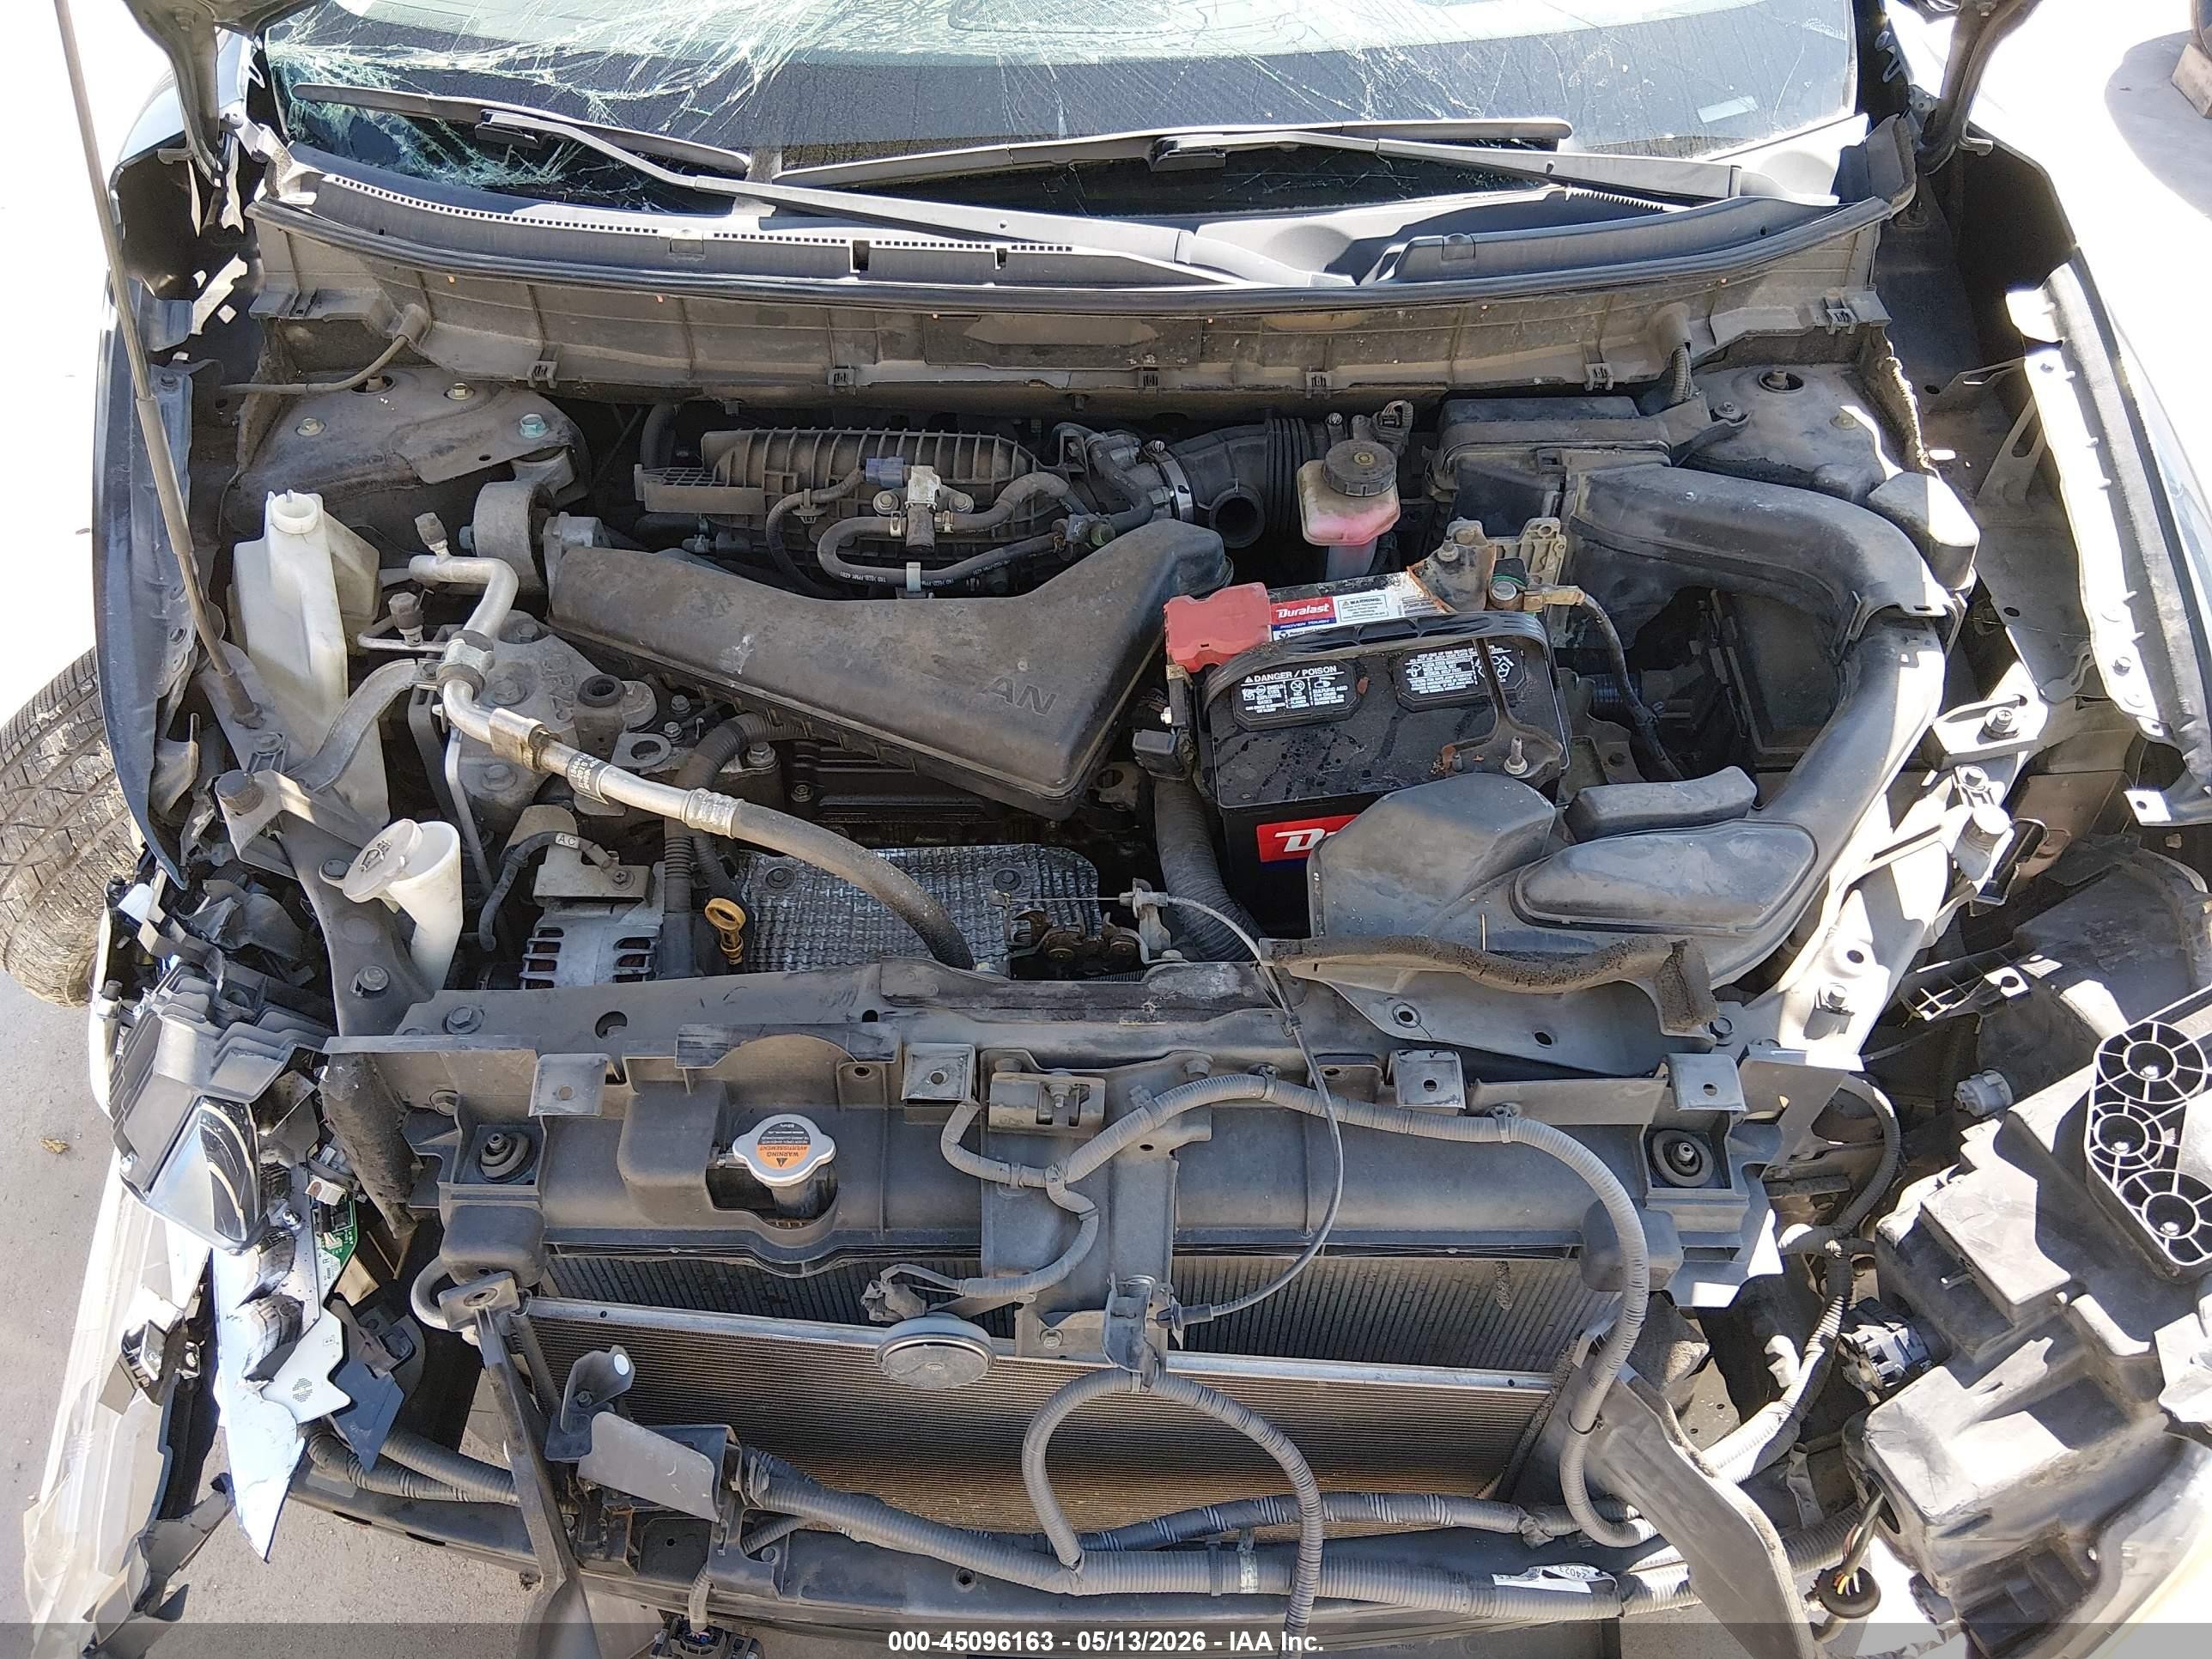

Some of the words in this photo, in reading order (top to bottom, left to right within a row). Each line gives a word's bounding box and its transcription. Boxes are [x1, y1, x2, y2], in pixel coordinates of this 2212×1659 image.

[1276, 603, 1329, 618] Duralast
[1254, 672, 1292, 682] DANGER
[1302, 665, 1337, 677] POISON
[1559, 1565, 1587, 1579] 24023
